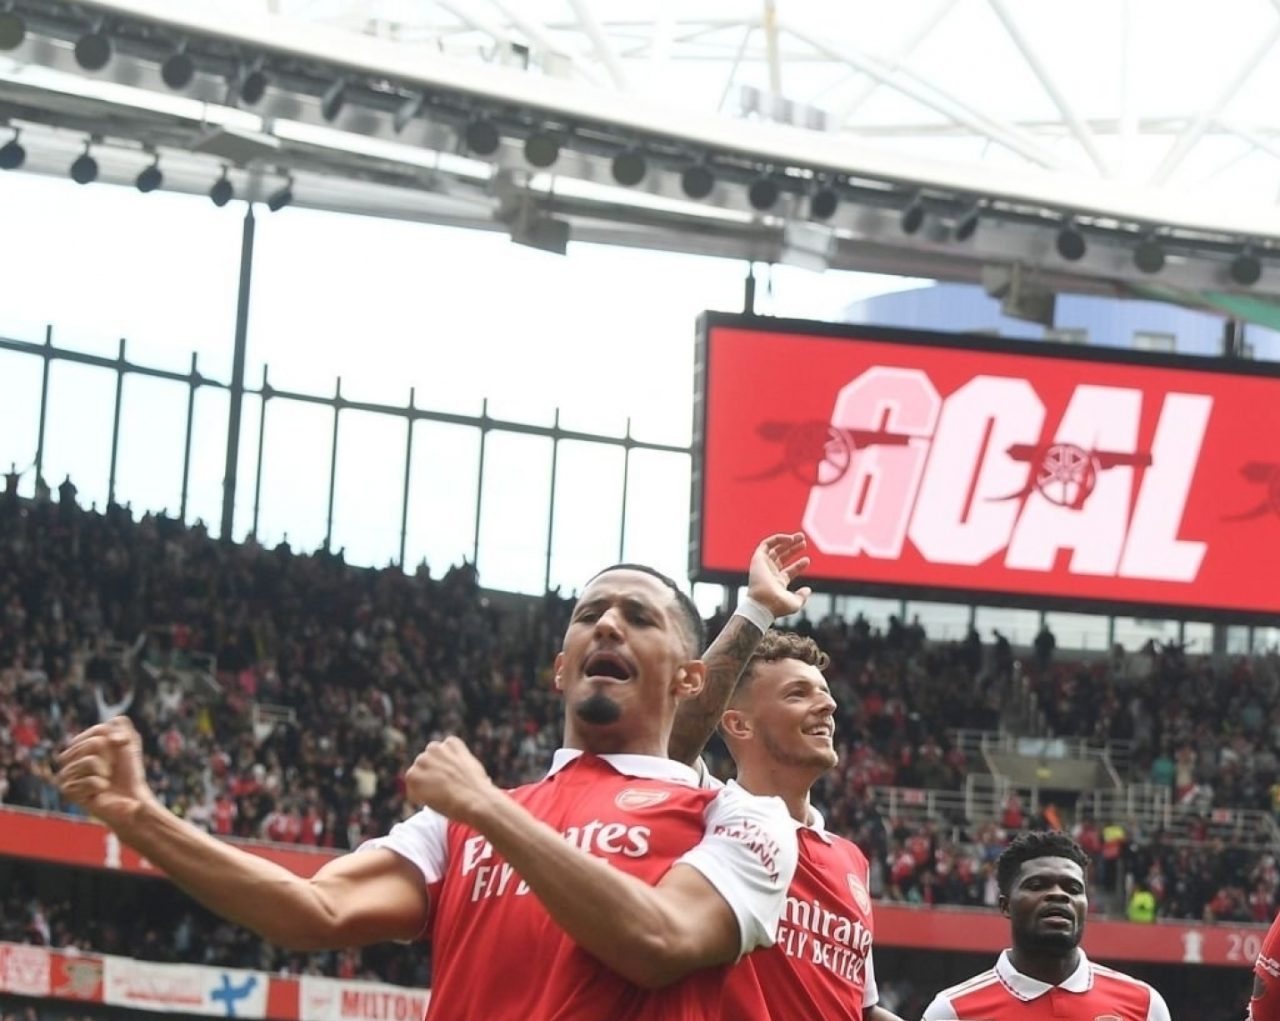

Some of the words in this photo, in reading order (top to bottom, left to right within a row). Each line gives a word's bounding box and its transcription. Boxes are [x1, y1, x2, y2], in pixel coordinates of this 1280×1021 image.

[802, 365, 1214, 583] GOAL
[462, 819, 652, 877] Eates
[471, 863, 515, 902] FLY
[777, 926, 808, 959] FLY
[812, 939, 865, 985] BETTER
[780, 896, 873, 957] mirate
